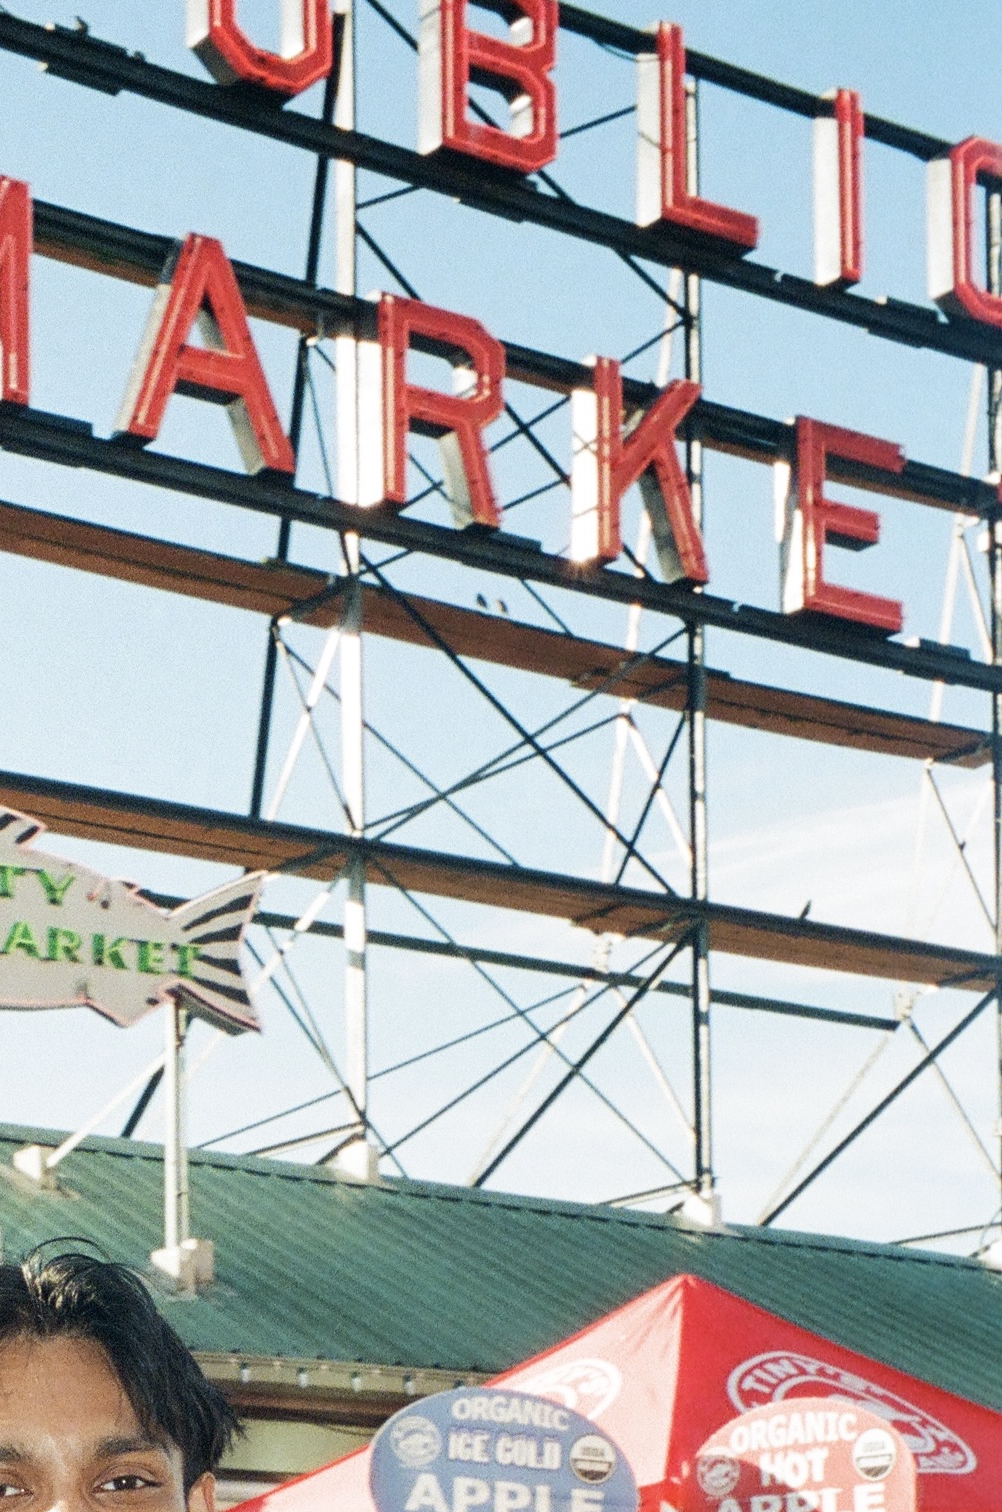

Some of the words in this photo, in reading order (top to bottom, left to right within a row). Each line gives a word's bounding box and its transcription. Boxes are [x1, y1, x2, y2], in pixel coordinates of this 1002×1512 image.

[451, 1396, 570, 1431] ORGANIC
[448, 1431, 489, 1463] ICE
[496, 1436, 561, 1470] COLD
[728, 1411, 858, 1456] ORGANIC
[758, 1448, 830, 1488] HOT
